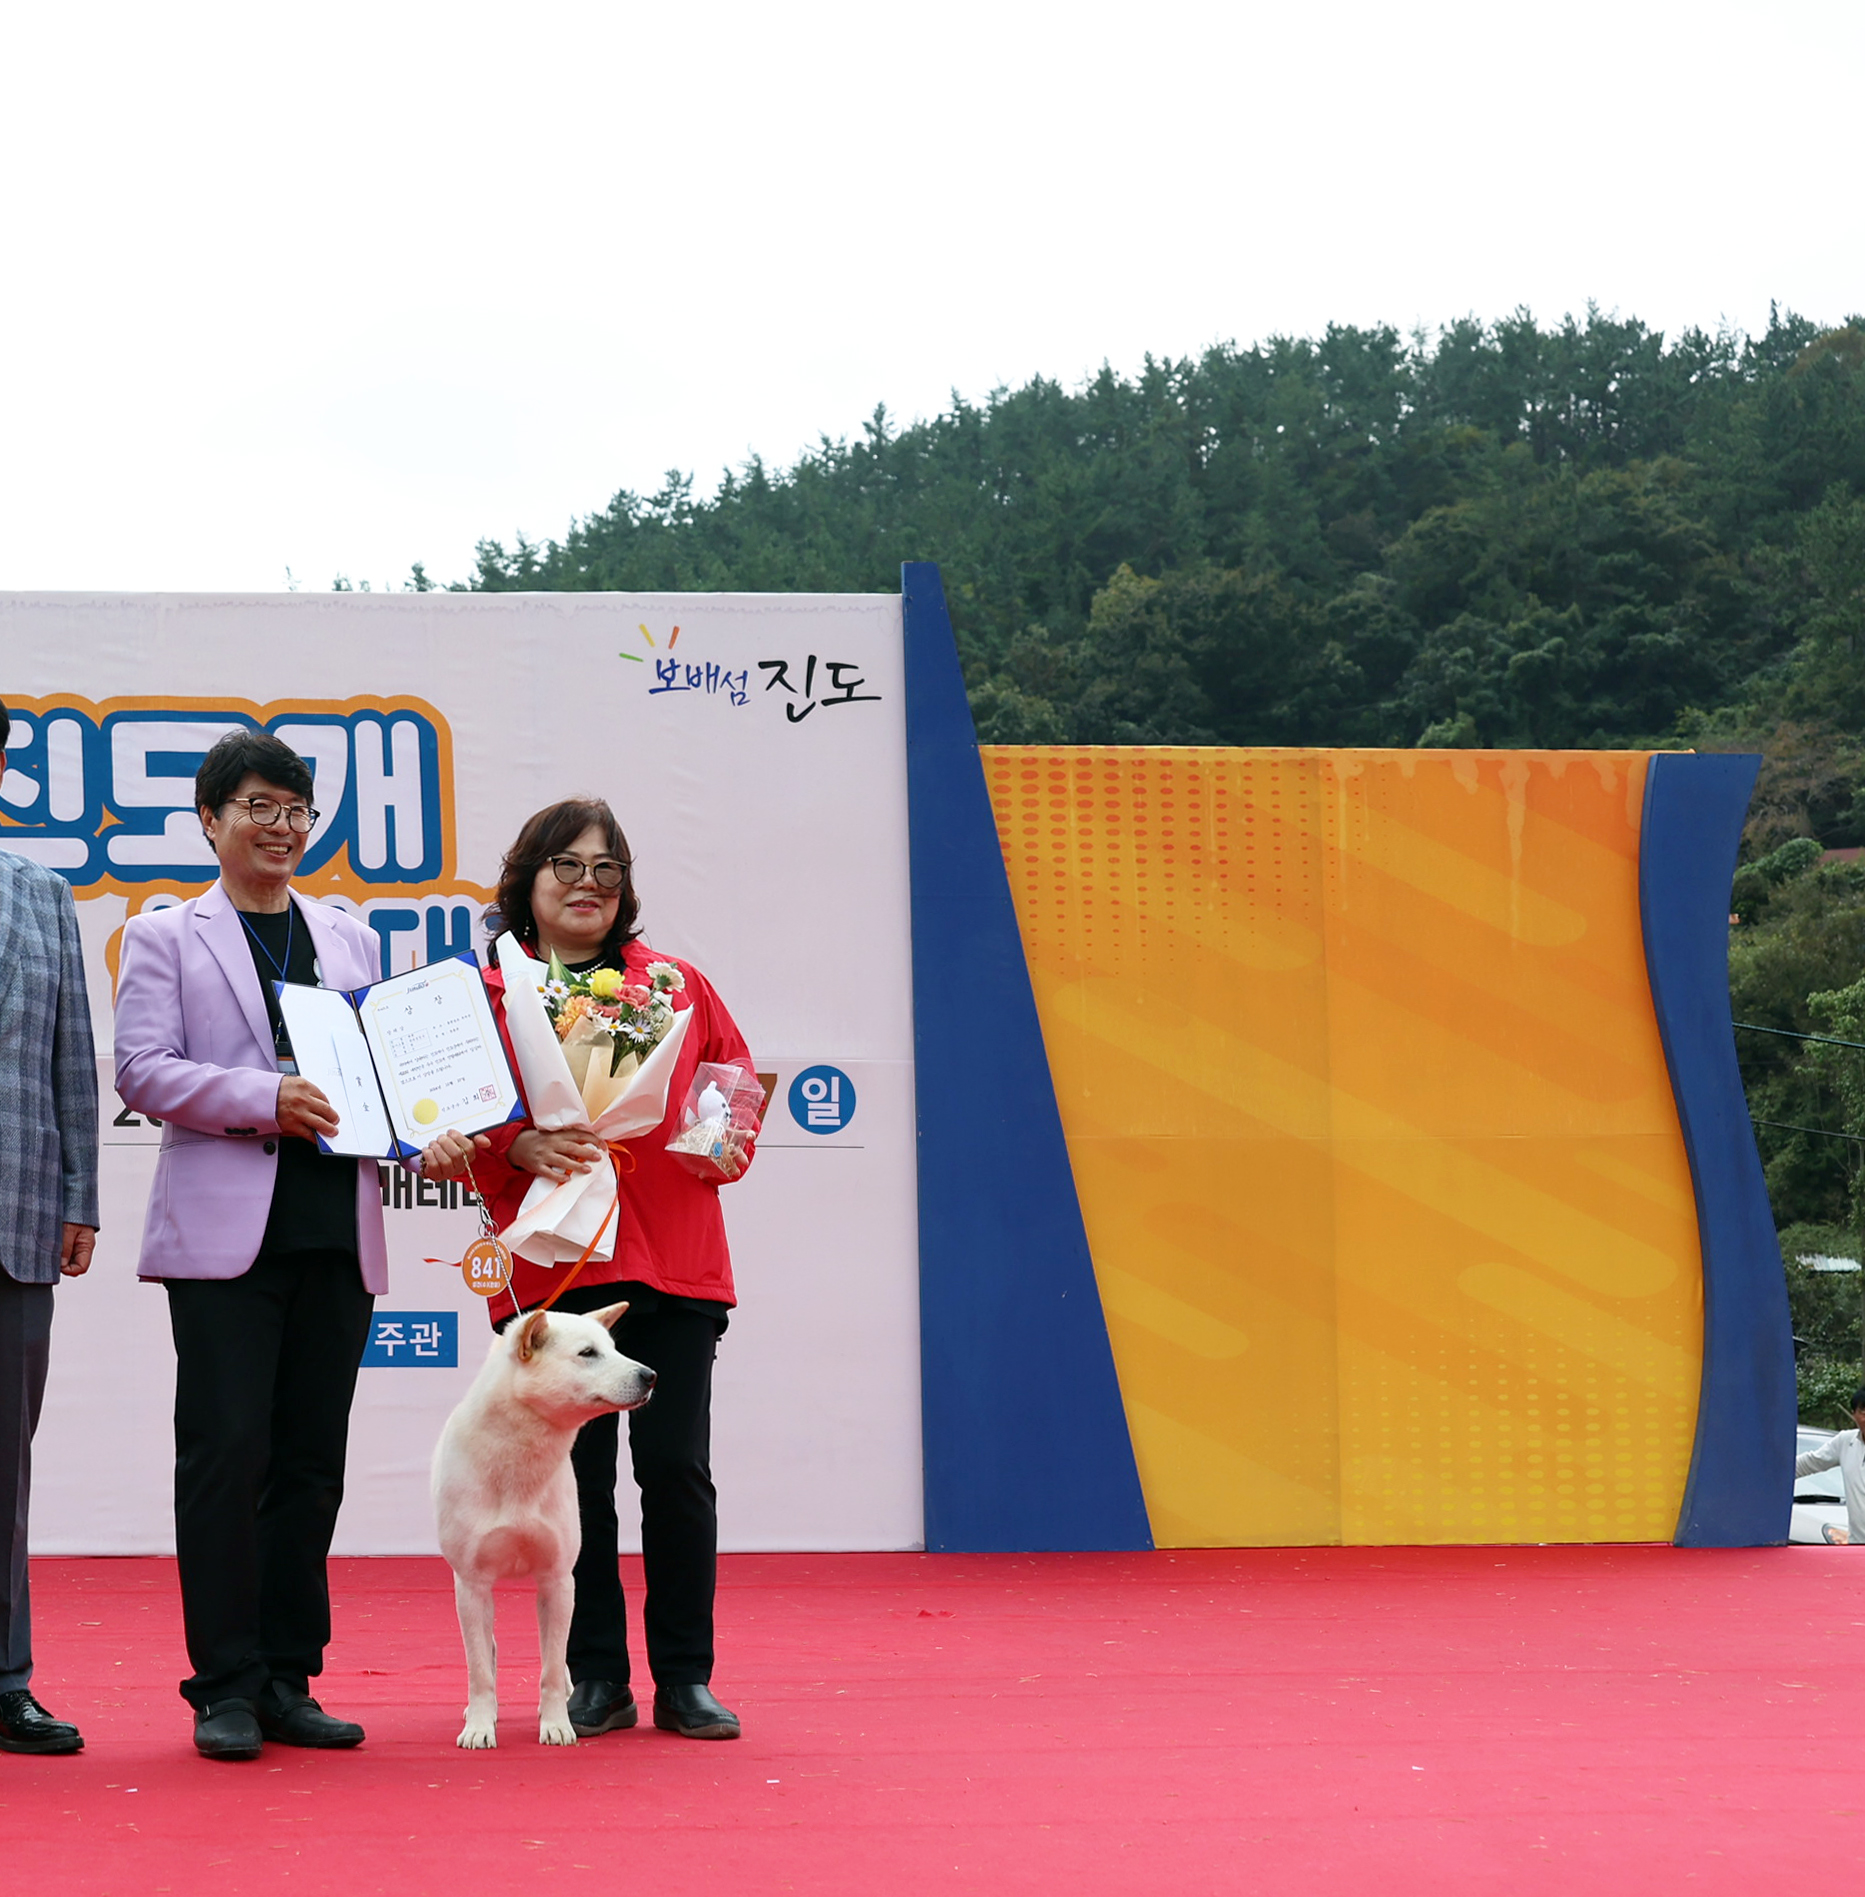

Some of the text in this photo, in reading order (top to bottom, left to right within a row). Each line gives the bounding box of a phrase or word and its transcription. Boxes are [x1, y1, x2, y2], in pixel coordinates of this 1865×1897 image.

[648, 654, 883, 724] 보배섬 진도
[801, 1076, 842, 1126] 일
[470, 1256, 502, 1279] 841
[374, 1321, 443, 1357] 주관
